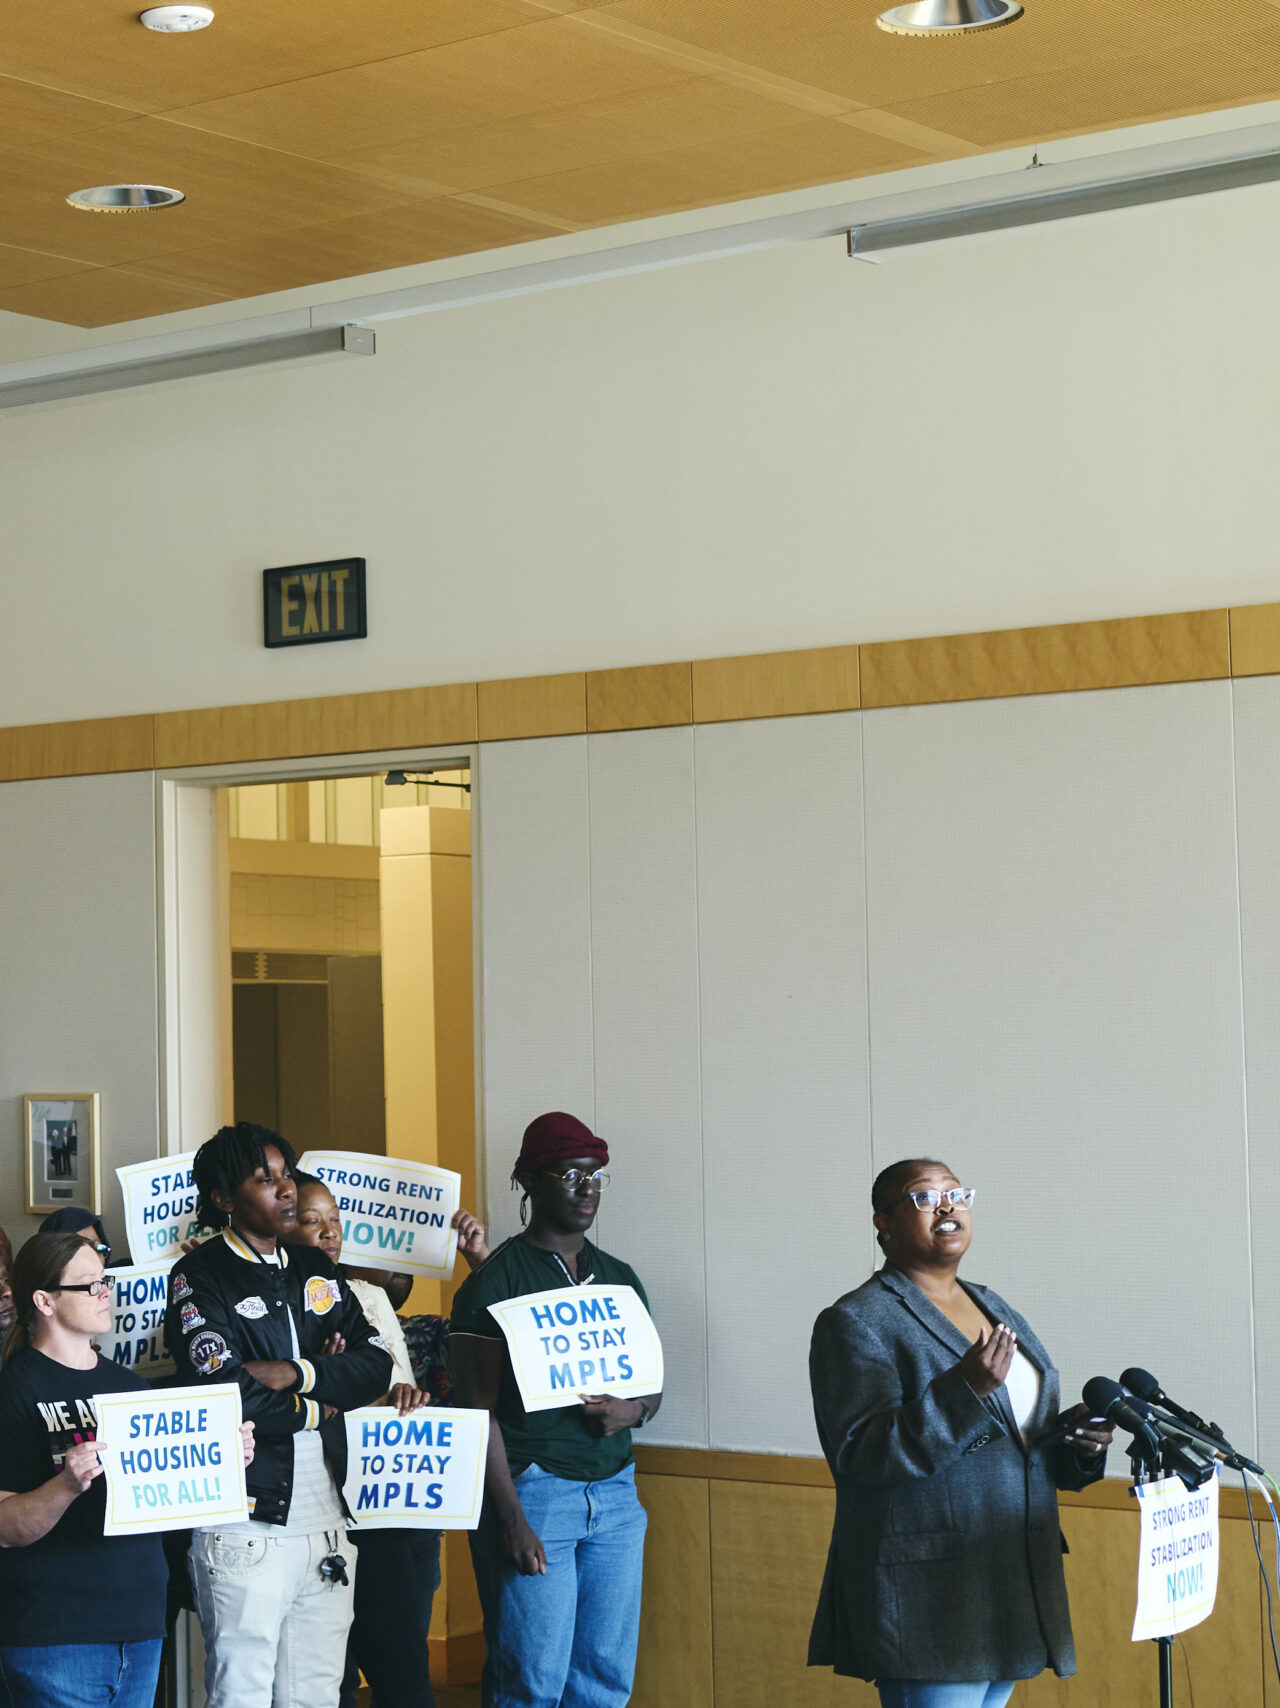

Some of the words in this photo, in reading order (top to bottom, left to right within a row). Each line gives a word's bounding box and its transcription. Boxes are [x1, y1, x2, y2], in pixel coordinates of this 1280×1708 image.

[281, 569, 349, 637] EXIT
[316, 1167, 391, 1192] STRONG
[396, 1181, 443, 1202] RENT
[337, 1196, 444, 1228] BILIZATION
[147, 1226, 180, 1251] FOR
[116, 1275, 168, 1307] HOM
[115, 1313, 136, 1334] TO
[141, 1308, 166, 1330] STA
[530, 1297, 620, 1329] HOME
[540, 1334, 570, 1355] TO
[579, 1327, 627, 1352] STAY
[549, 1354, 634, 1390] MPLS
[37, 1401, 76, 1432] WE
[129, 1408, 208, 1439] STABLE
[362, 1420, 453, 1448] HOME
[120, 1441, 222, 1475] HOUSING
[361, 1455, 385, 1476] TO
[392, 1453, 452, 1475] STAY
[132, 1482, 173, 1509] FOR
[177, 1476, 222, 1505] ALL!
[356, 1482, 443, 1510] MPLS
[1152, 1503, 1186, 1531] STRONG
[1188, 1496, 1210, 1520] RENT
[1151, 1529, 1213, 1567] STABILIZATION
[1167, 1562, 1203, 1604] NOW!
